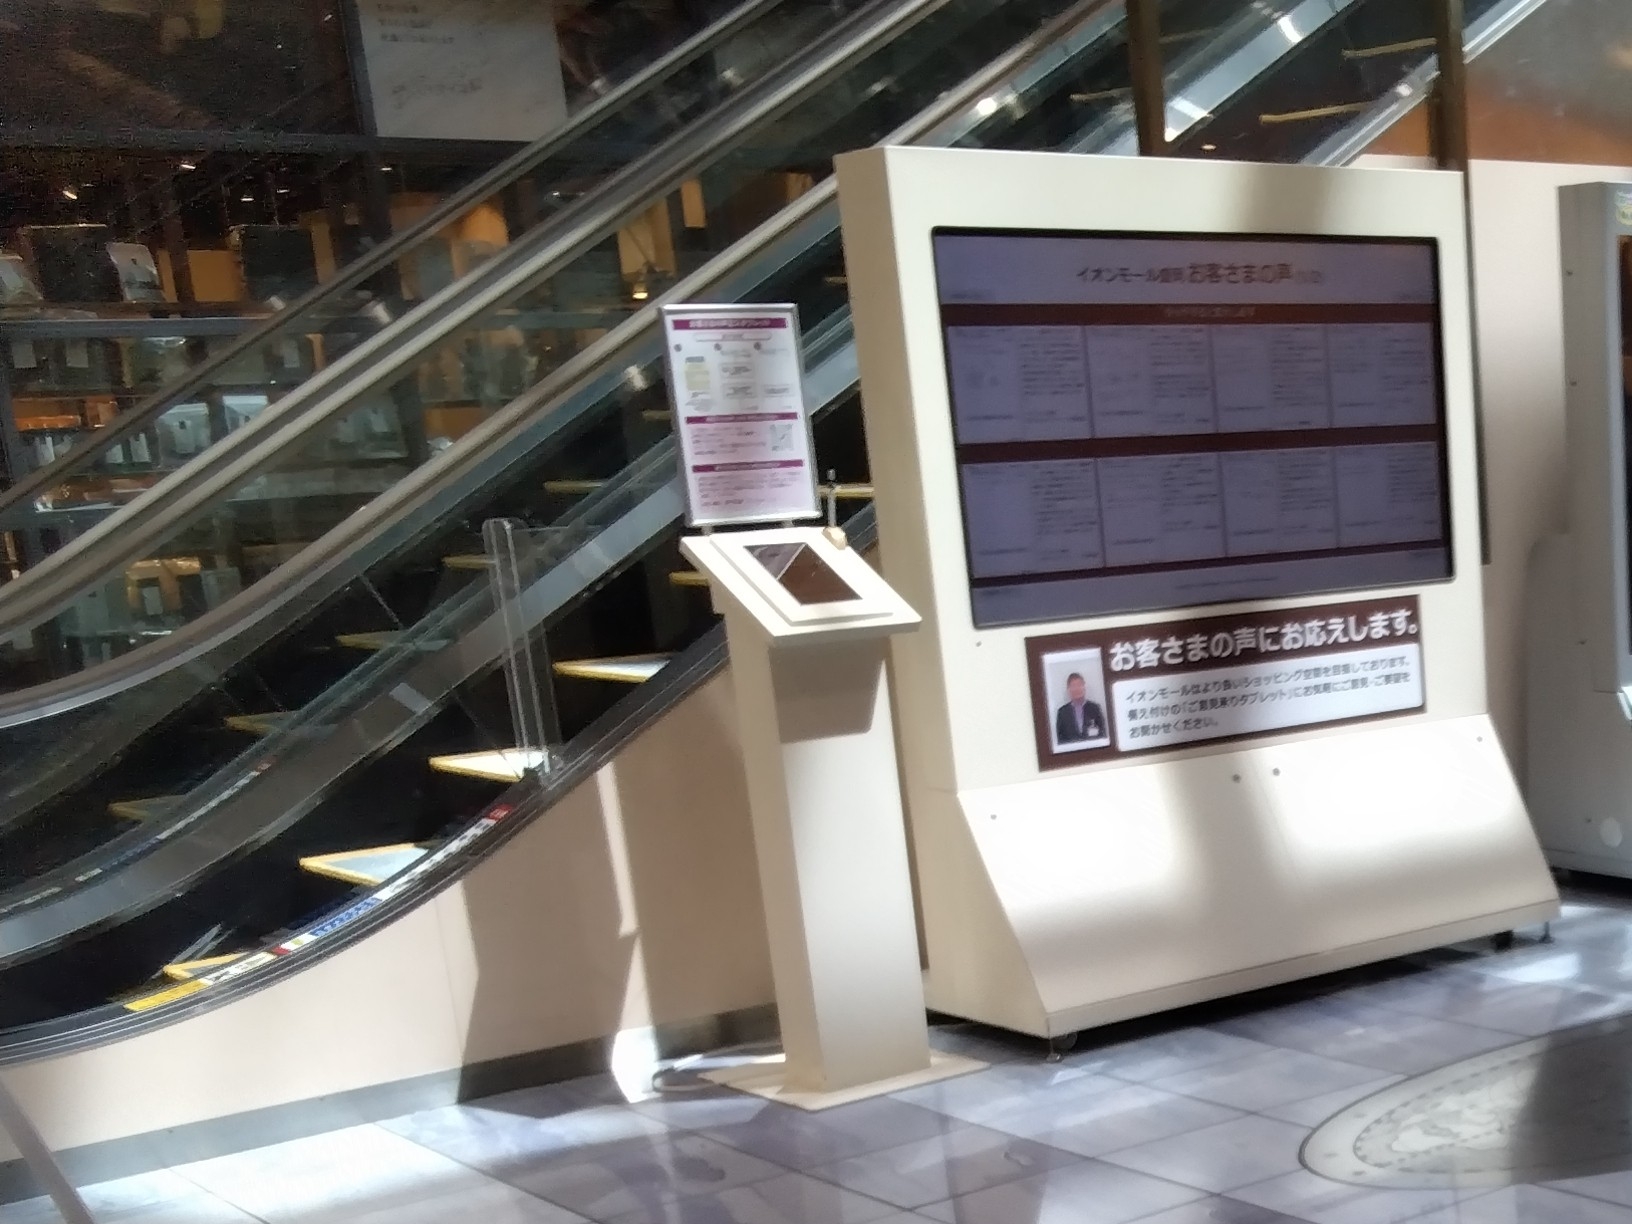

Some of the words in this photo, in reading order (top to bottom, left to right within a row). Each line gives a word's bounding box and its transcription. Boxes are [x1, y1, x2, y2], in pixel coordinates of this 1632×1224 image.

[1109, 610, 1418, 672] お客さまの声にお応えします。
